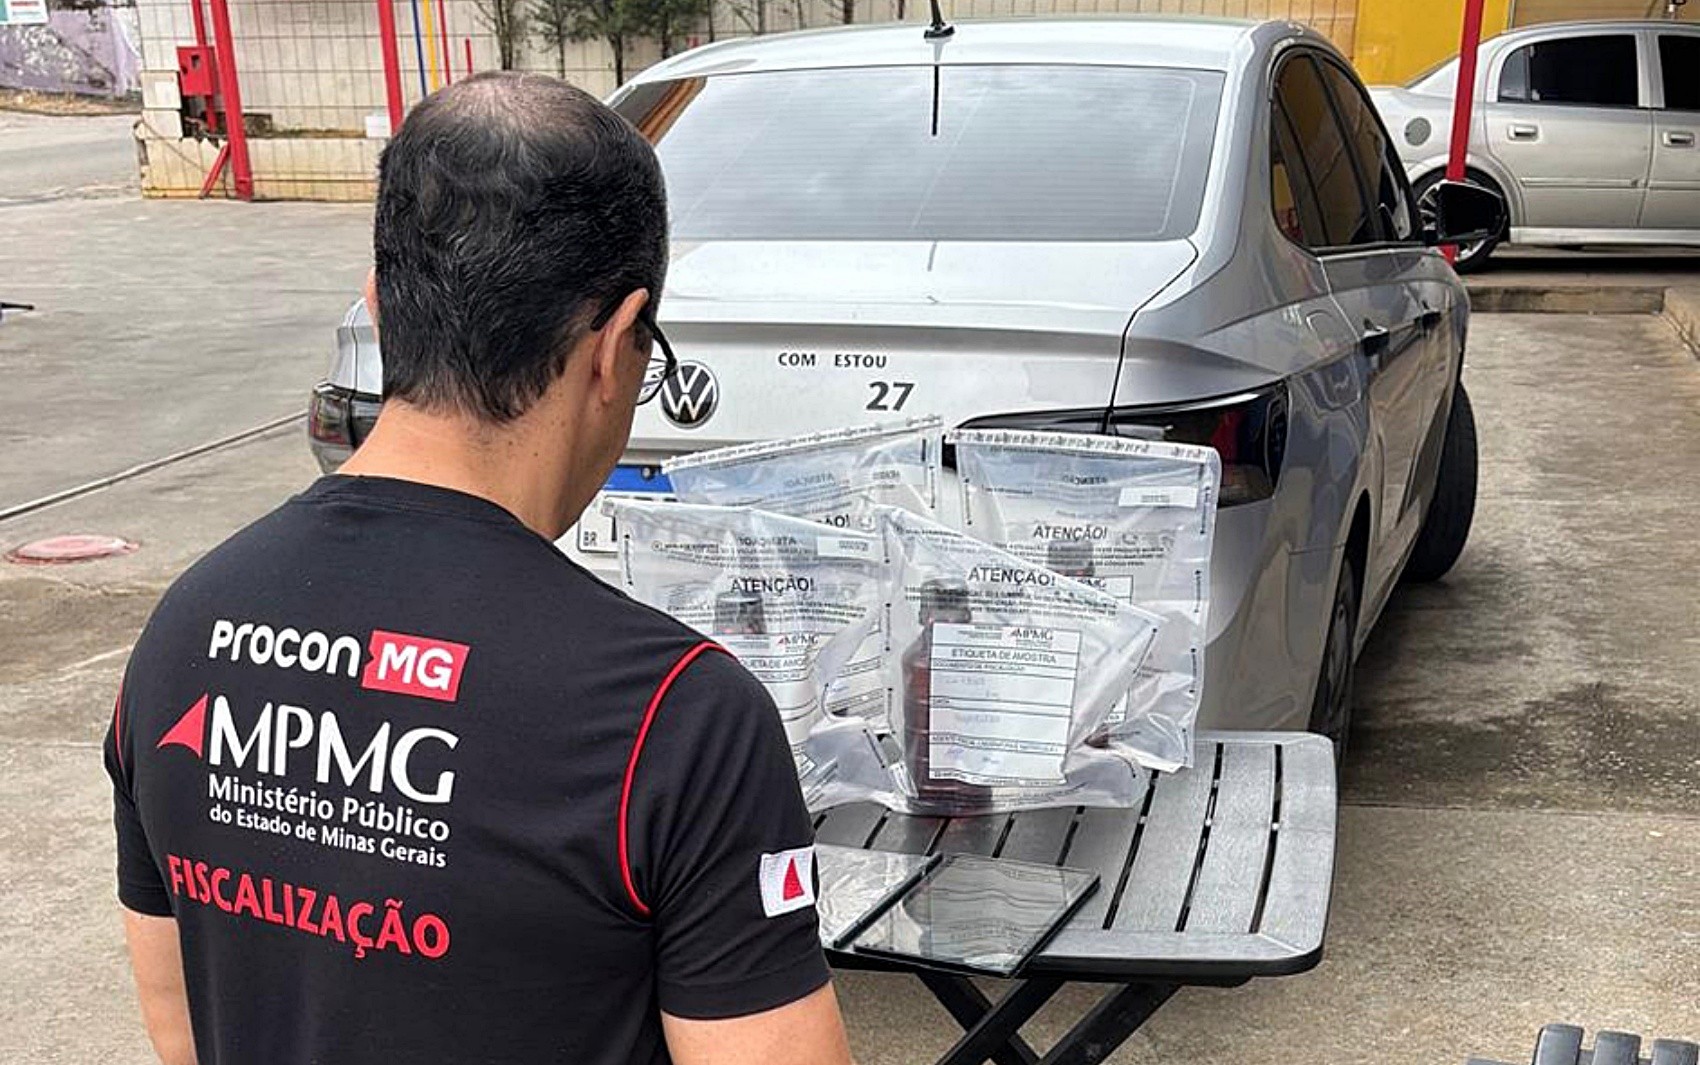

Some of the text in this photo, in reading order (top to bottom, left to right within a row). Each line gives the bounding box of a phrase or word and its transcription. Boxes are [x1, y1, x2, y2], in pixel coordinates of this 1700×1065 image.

[778, 353, 887, 368] COM ESTOU
[866, 381, 914, 411] 27
[1034, 525, 1108, 542] ATENÇÃO!
[730, 575, 816, 595] ATENÇÃO!
[968, 566, 1056, 587] ATENÇÃO!
[376, 641, 454, 691] MG
[208, 695, 459, 803] MPMG
[208, 773, 450, 842] Ministério Público
[209, 804, 447, 868] do Estado de Minas Gerais
[168, 854, 451, 960] FISCALIZAÇÃO
